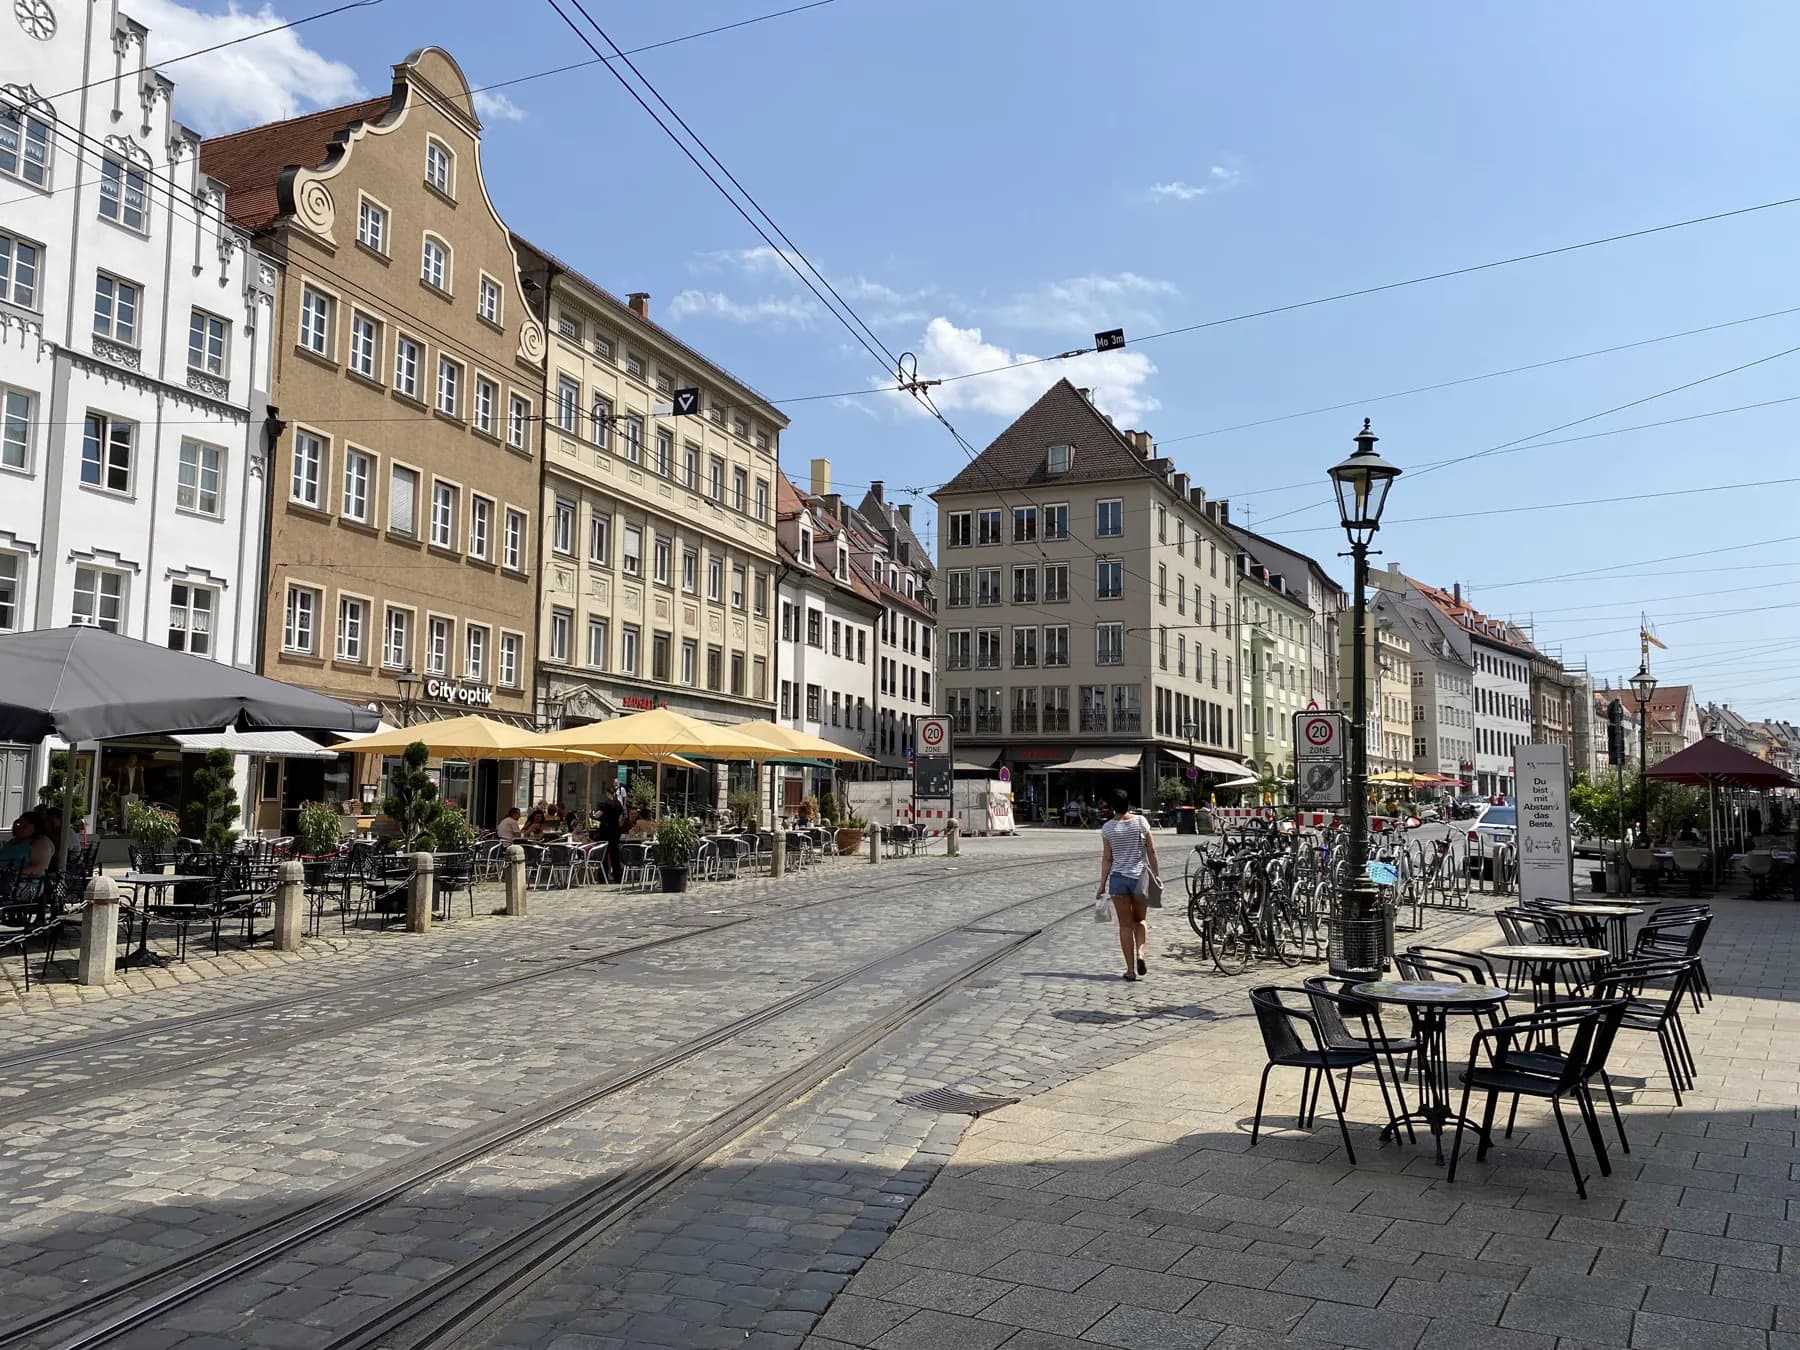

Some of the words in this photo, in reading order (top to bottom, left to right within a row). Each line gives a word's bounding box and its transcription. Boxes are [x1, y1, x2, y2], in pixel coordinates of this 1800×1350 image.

[1097, 337, 1109, 348] Mo
[1110, 334, 1124, 345] 3m
[428, 679, 457, 702] City
[459, 686, 493, 705] optik
[927, 728, 940, 739] 20
[1311, 725, 1328, 738] 20
[1309, 746, 1331, 754] ZONE
[1533, 777, 1547, 785] Du
[1532, 786, 1549, 794] bist
[1533, 794, 1549, 802] mit
[1529, 820, 1555, 828] Beste.
